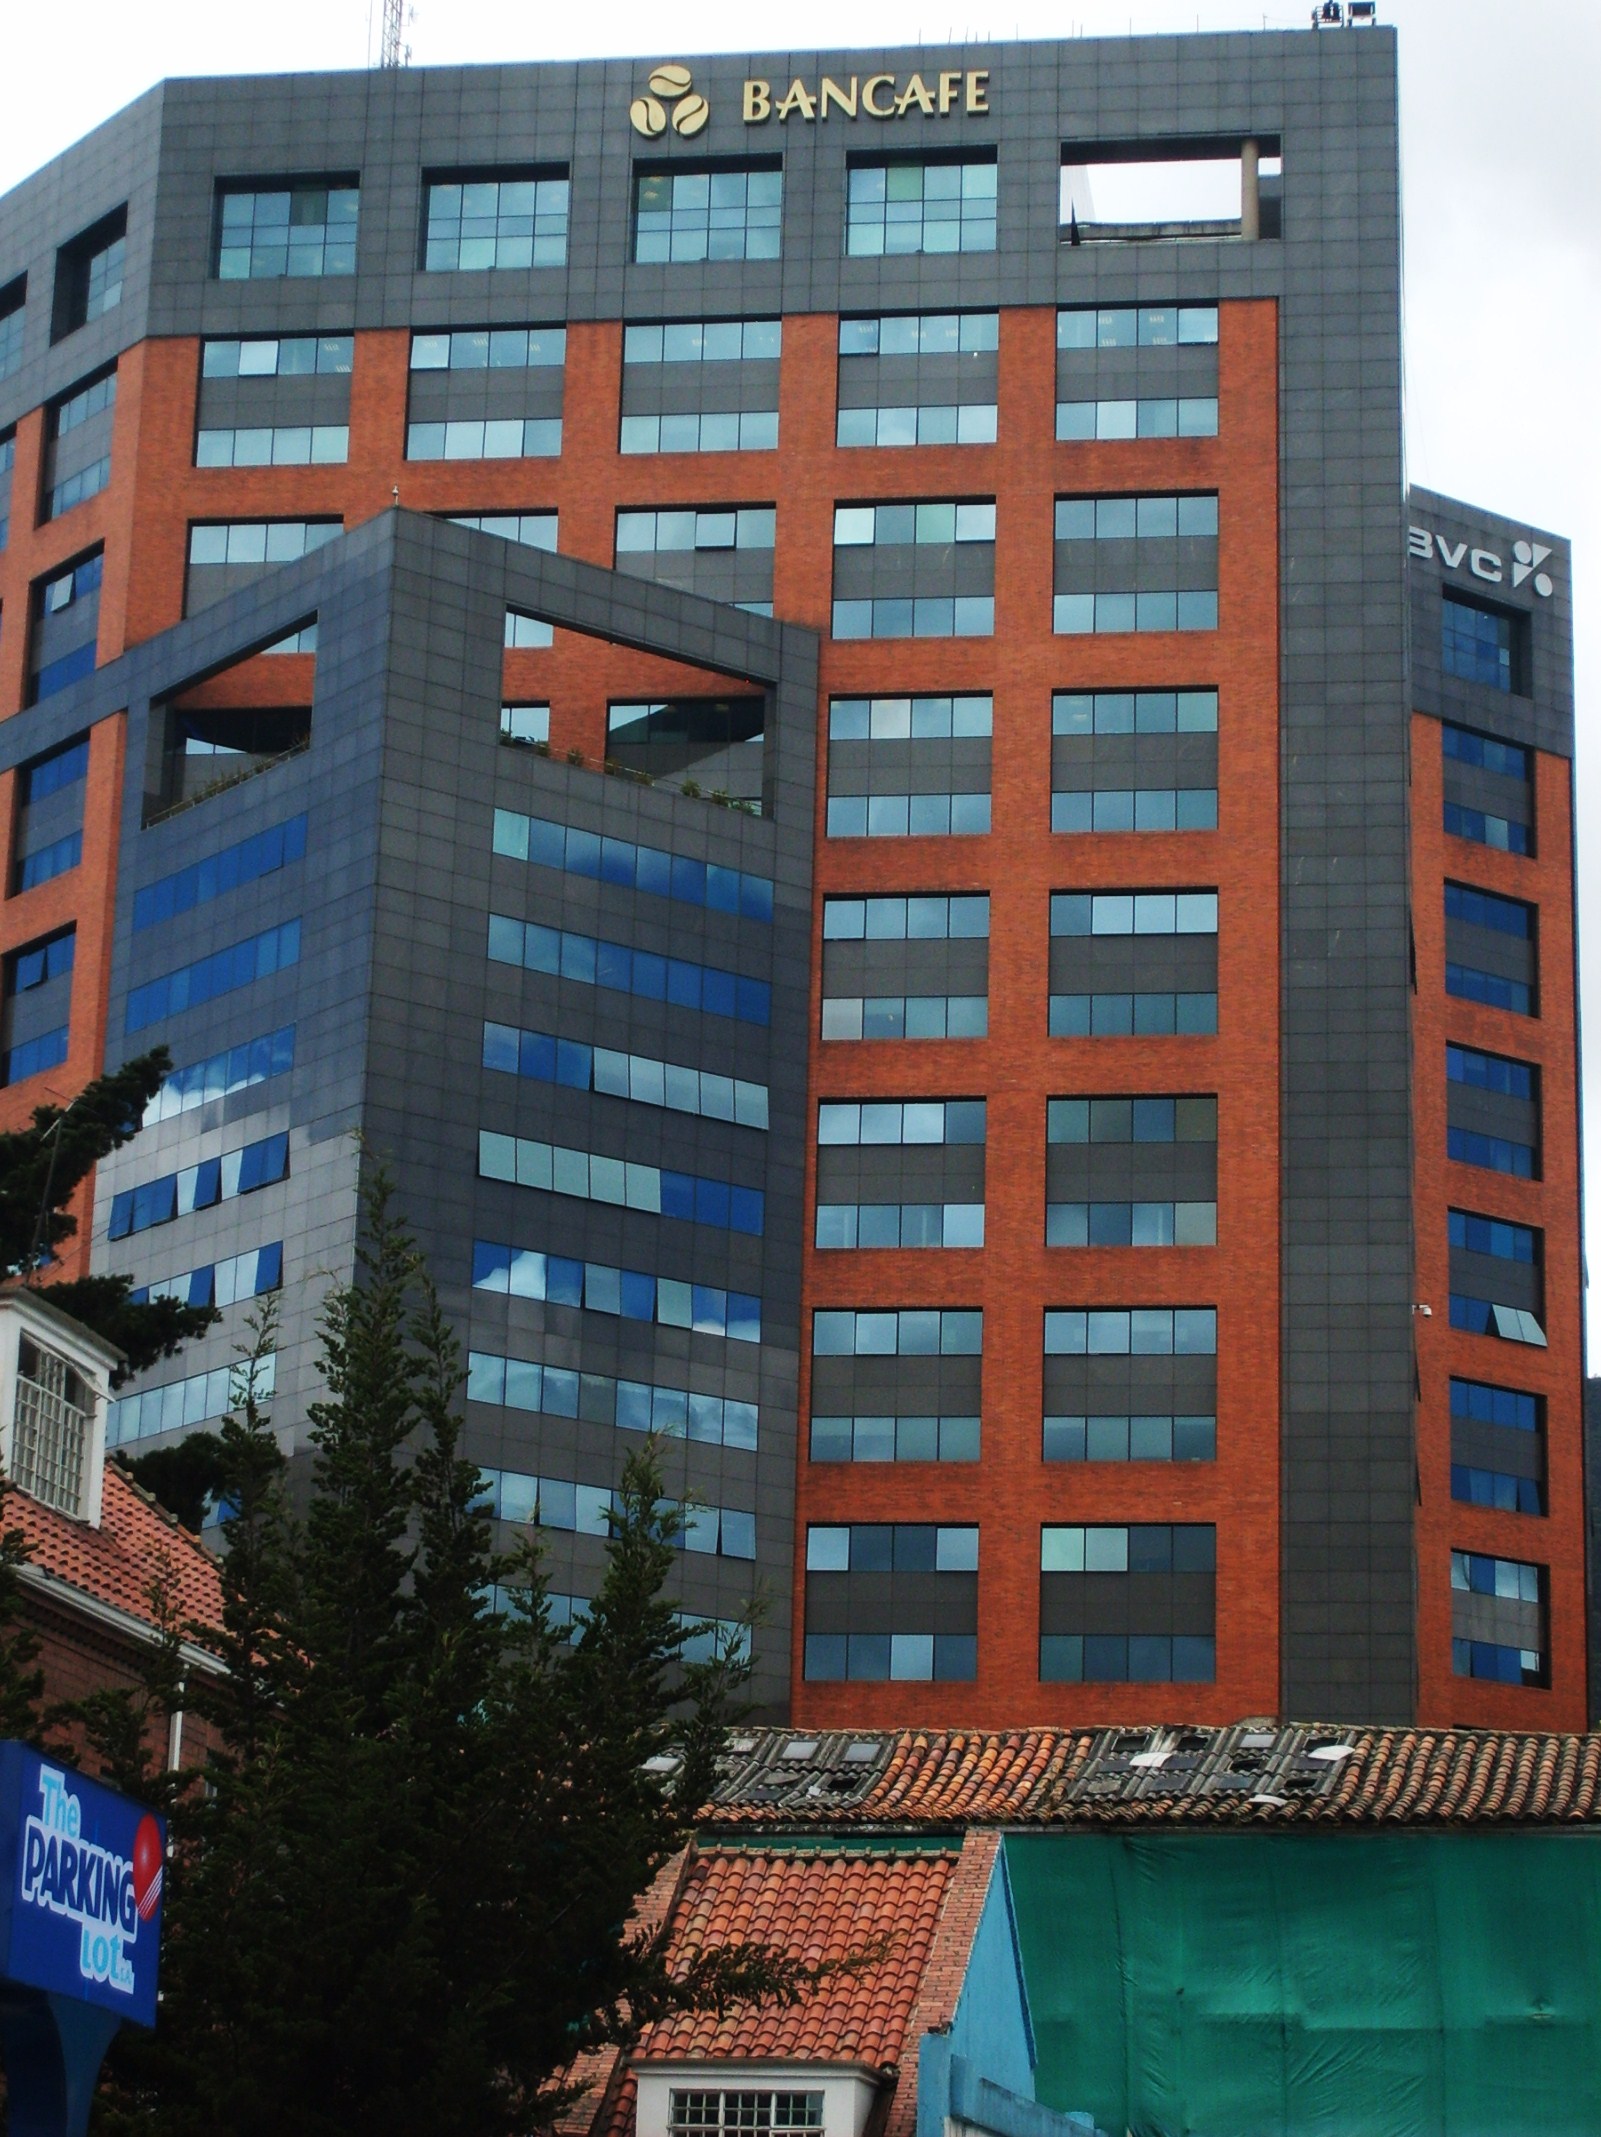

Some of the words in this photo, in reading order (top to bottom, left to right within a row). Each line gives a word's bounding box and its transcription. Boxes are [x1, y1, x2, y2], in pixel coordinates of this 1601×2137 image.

[743, 71, 990, 124] BANCAFE
[40, 1765, 80, 1838] The
[23, 1817, 137, 1940] PARKING
